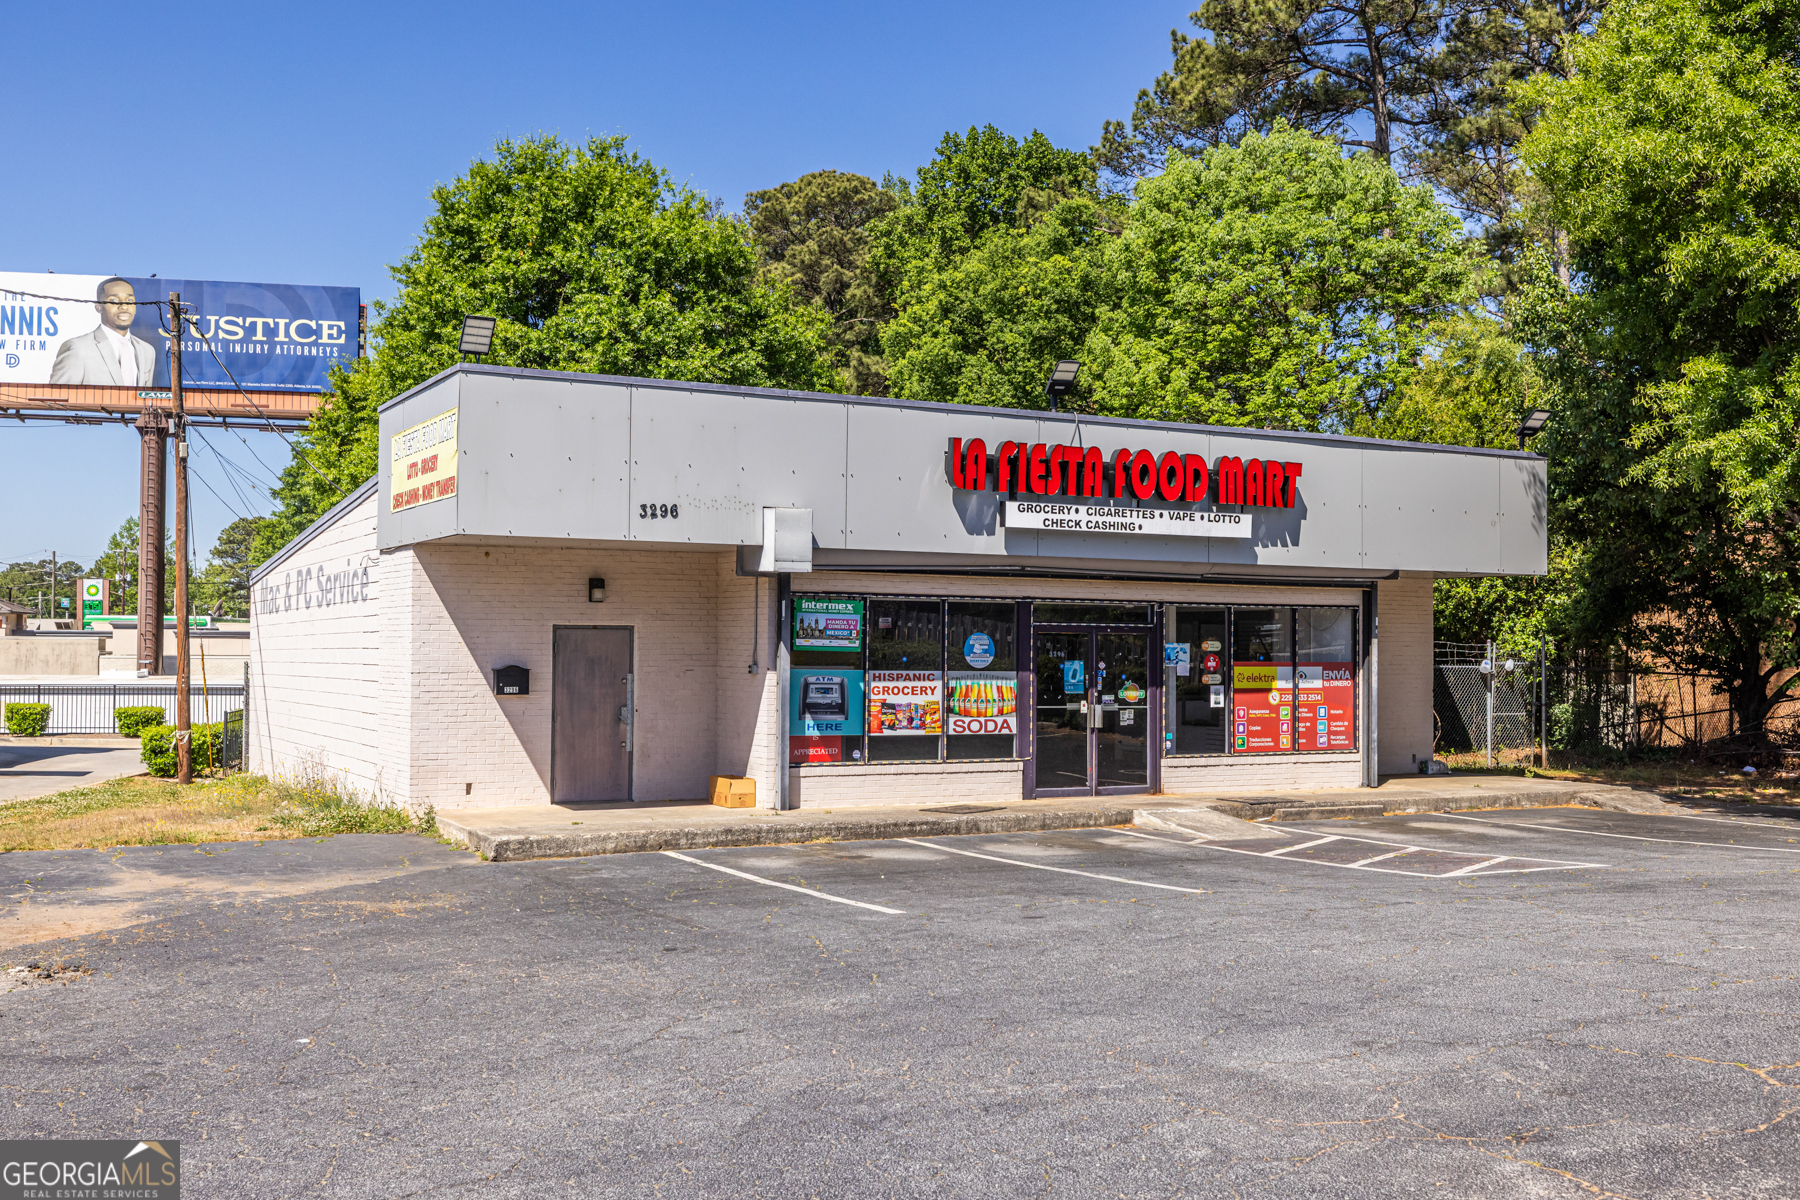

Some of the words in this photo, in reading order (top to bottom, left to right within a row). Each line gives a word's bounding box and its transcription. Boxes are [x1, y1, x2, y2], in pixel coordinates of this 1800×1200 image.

[16, 339, 46, 351] FIRM
[166, 341, 222, 353] PRSONAL
[230, 343, 269, 354] INJURY
[276, 345, 338, 357] ATTORNEYS
[421, 421, 437, 451] FOOD
[438, 413, 456, 444] MART
[407, 461, 418, 480] LOTTO
[421, 453, 439, 476] GROCERY
[950, 437, 987, 491] LA
[996, 440, 1103, 497] FIESTA
[1111, 447, 1209, 502] FOOD
[1215, 455, 1302, 509] MART
[393, 491, 404, 510] CHECK
[405, 487, 420, 507] CASHING
[421, 482, 436, 502] MONEY
[436, 475, 456, 498] TRANSFER
[639, 503, 679, 520] 3296
[1017, 503, 1073, 515] GROCERY
[1086, 506, 1155, 520] CIGARETTES
[1168, 511, 1196, 521] VAPE
[1207, 513, 1241, 524] LOTTO
[1043, 518, 1082, 529] CHECK
[1085, 520, 1136, 532] CASHING
[284, 572, 292, 613] &
[296, 567, 312, 611] PC
[316, 558, 369, 610] Service
[872, 673, 935, 682] HISPANIC
[1246, 673, 1275, 683] elektra
[1323, 668, 1351, 680] ENVÍA
[871, 686, 937, 696] GROCERY
[807, 723, 842, 731] HERE
[953, 718, 1013, 734] SODA
[793, 747, 838, 756] APPRECIATED
